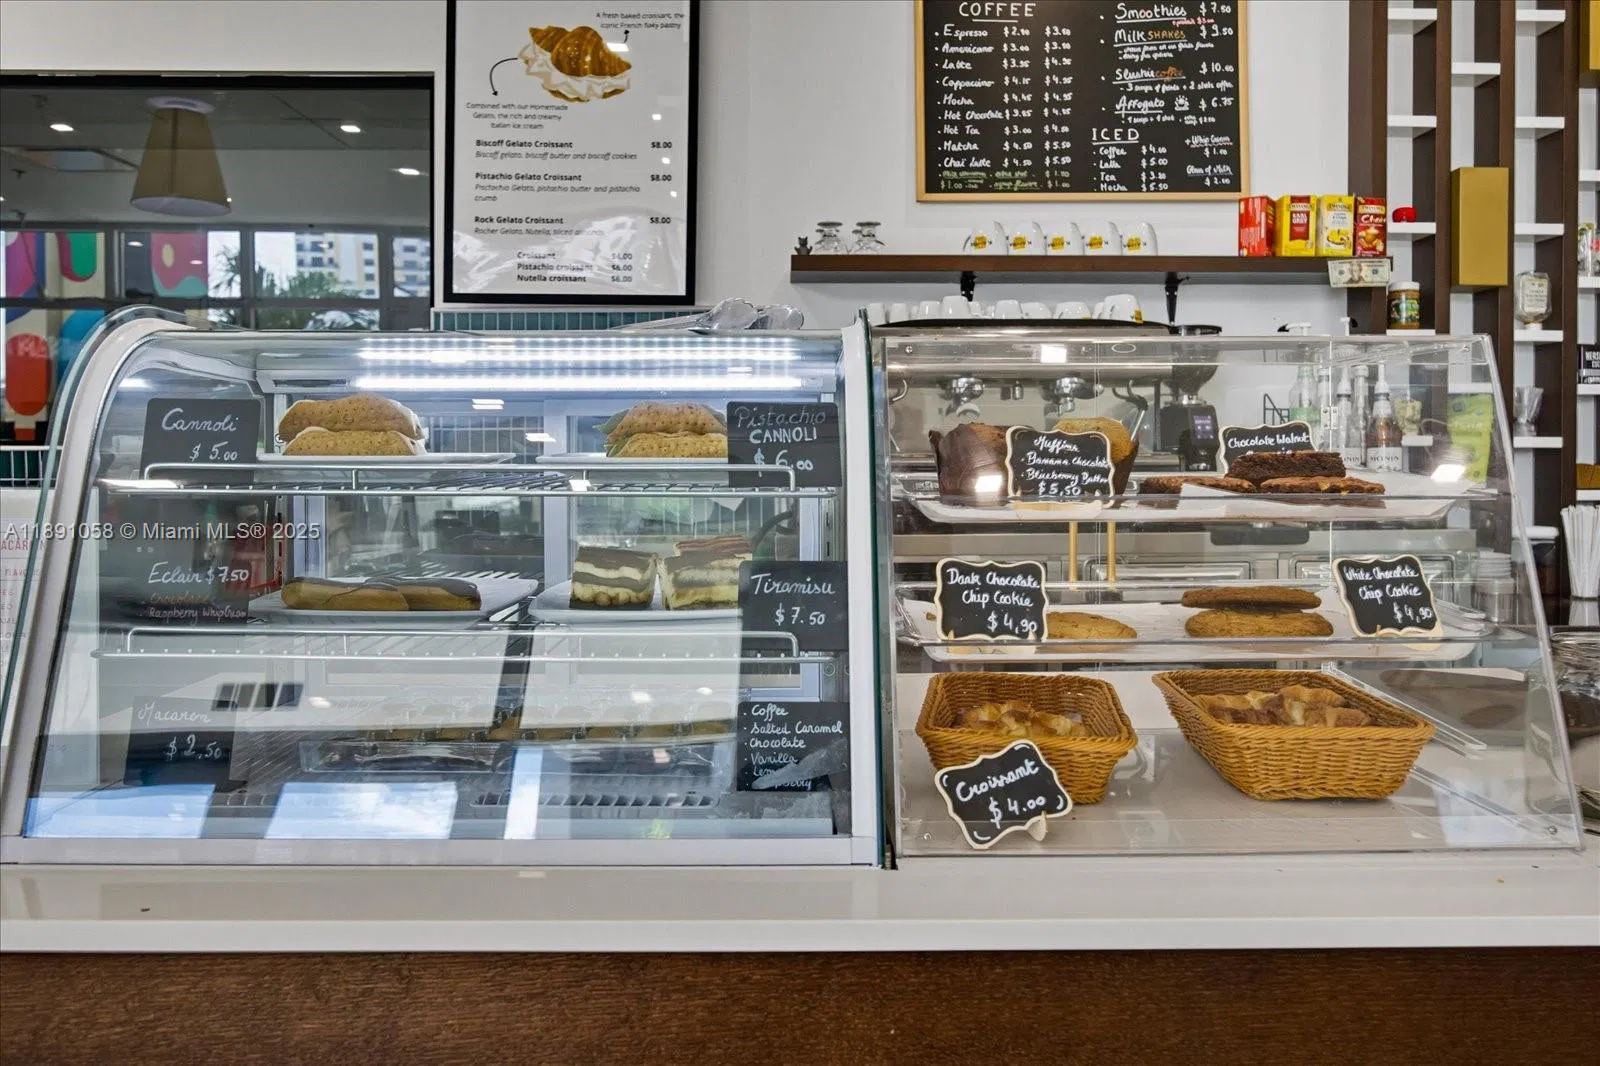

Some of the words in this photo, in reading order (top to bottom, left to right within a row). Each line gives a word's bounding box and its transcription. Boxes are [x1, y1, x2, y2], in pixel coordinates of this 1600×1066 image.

[958, 2, 1037, 17] COFFEE
[1114, 2, 1187, 20] Smoothies
[943, 24, 989, 40] Espresso
[466, 102, 500, 110] Combined
[502, 102, 516, 110] with
[944, 124, 960, 135] Hot
[965, 124, 981, 135] Tea
[1092, 128, 1140, 141] ICED
[476, 140, 504, 148] Biscoff
[505, 140, 533, 148] Gelato
[534, 140, 573, 149] Croissant
[944, 140, 979, 152] Matcha
[572, 152, 587, 160] and
[1099, 146, 1128, 159] Coffee
[475, 172, 513, 181] Pistachio
[514, 173, 542, 182] Gelato
[544, 173, 582, 182] Croissant
[1100, 172, 1117, 182] Tea
[474, 216, 495, 224] Rock
[496, 216, 523, 224] Gelato
[524, 216, 564, 224] Croissant
[516, 275, 547, 283] Nutella
[548, 275, 587, 283] croissant
[162, 408, 239, 432] Cannoli
[734, 406, 826, 428] Pistachio
[749, 426, 817, 444] CANNOLI
[1228, 434, 1276, 449] Chocolate
[1276, 432, 1310, 445] Walnut
[148, 561, 202, 584] Eclair
[946, 568, 982, 586] Dark
[986, 572, 1041, 589] Chocolate
[1372, 564, 1420, 581] Chocolate
[750, 572, 837, 595] Tiramisu
[962, 587, 990, 609] Chip
[993, 590, 1034, 608] Cookie
[1358, 584, 1383, 605] Chip
[1386, 582, 1423, 598] Cookie
[751, 702, 789, 722] Coffee
[750, 722, 792, 735] Salted
[795, 720, 844, 735] Caramel
[749, 737, 807, 749] Chocolate
[750, 752, 799, 766] Vanilla
[956, 758, 1040, 802] Croissant
